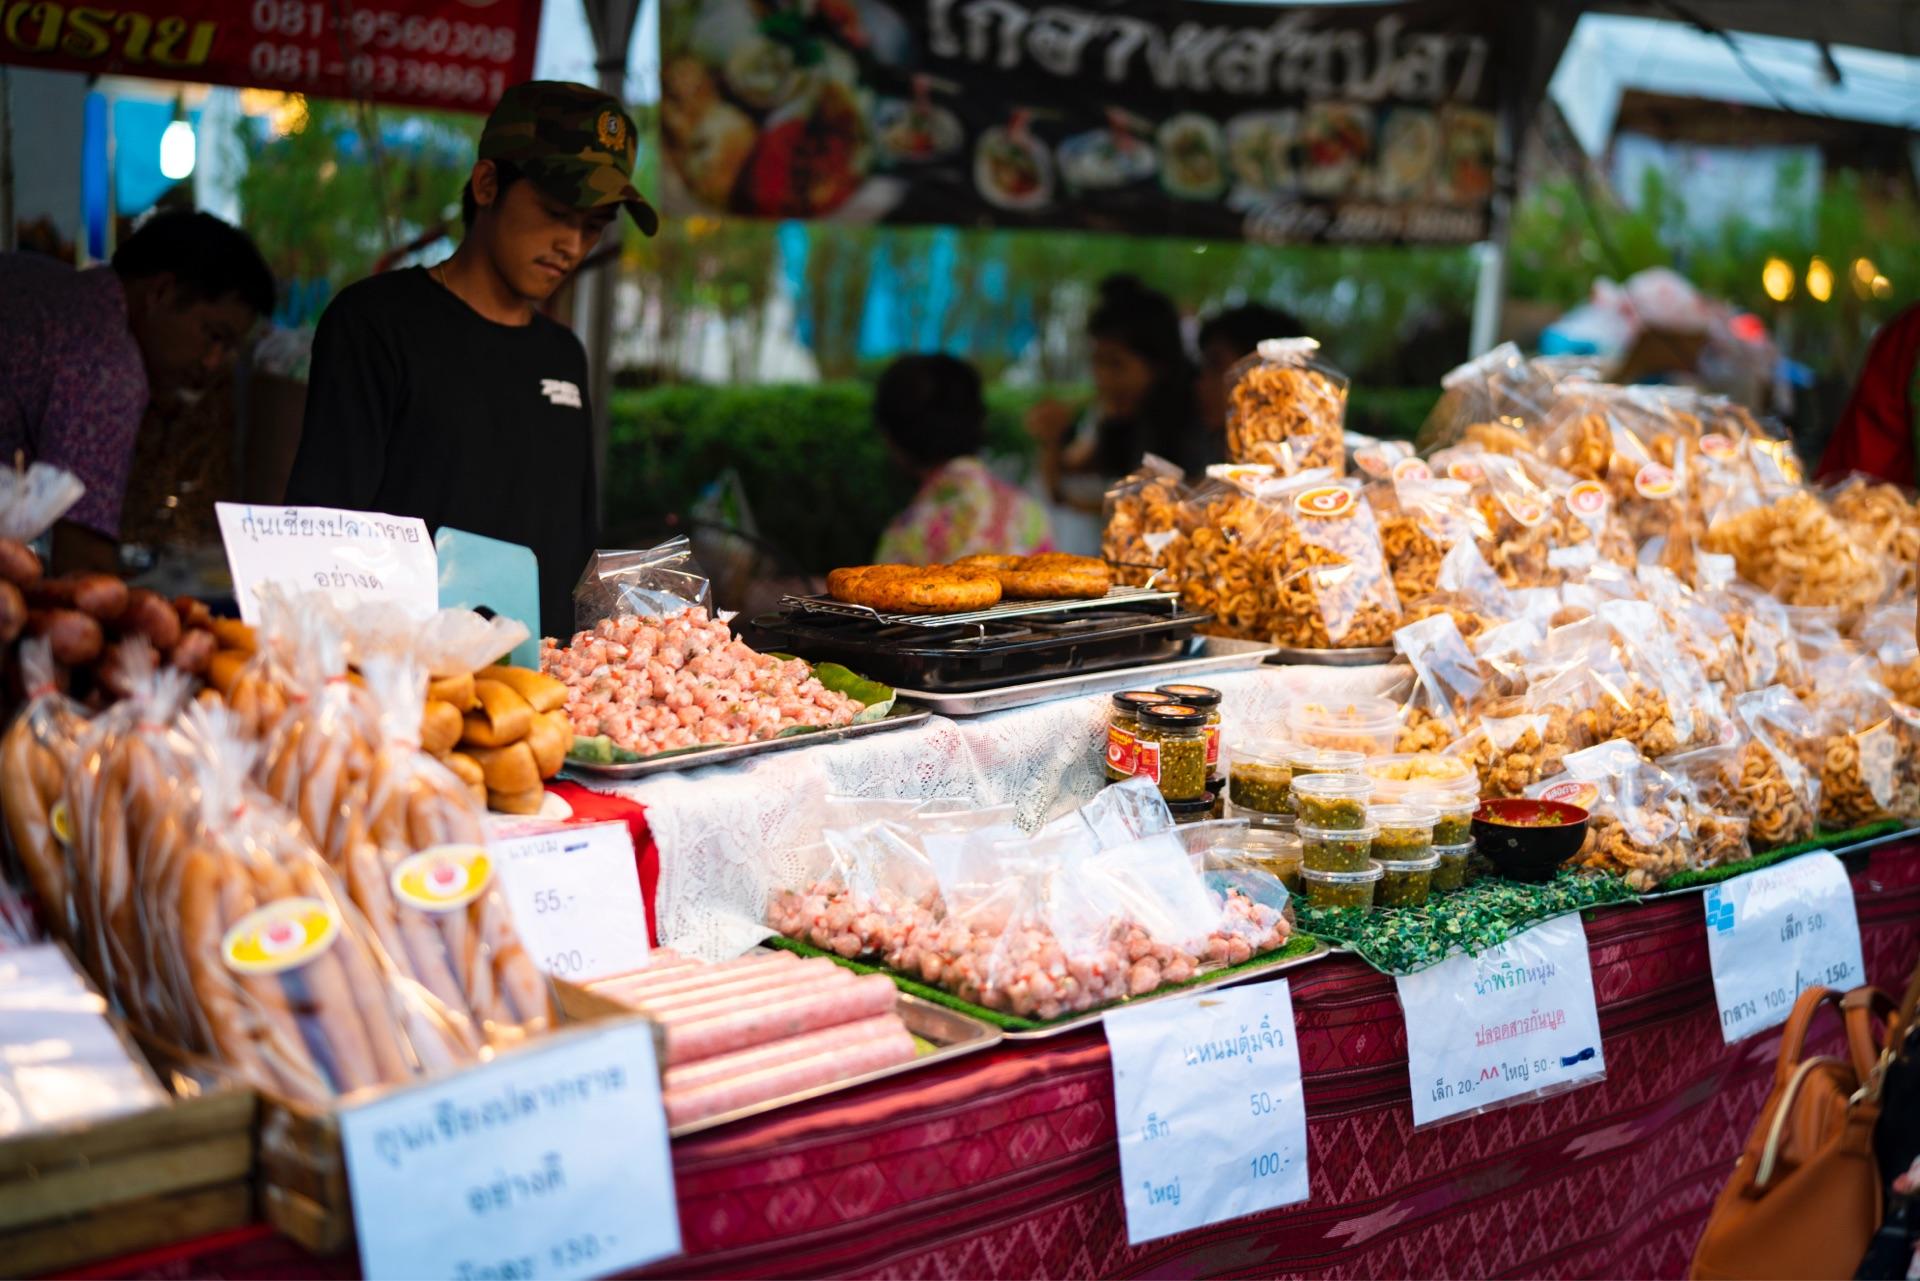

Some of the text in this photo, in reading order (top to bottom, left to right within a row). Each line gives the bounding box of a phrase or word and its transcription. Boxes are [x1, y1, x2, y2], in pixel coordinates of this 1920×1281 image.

[0, 1, 217, 67] งราย
[1475, 1007, 1567, 1047] ปลอดสารกันบูด
[1722, 1000, 1758, 1027] กลาง
[1431, 1076, 1454, 1103] เล็ก
[1501, 1057, 1530, 1083] ใหญ่
[1141, 1091, 1283, 1142] เล็ก 50.-
[1143, 1151, 1291, 1207] ใหญ่ 100.-
